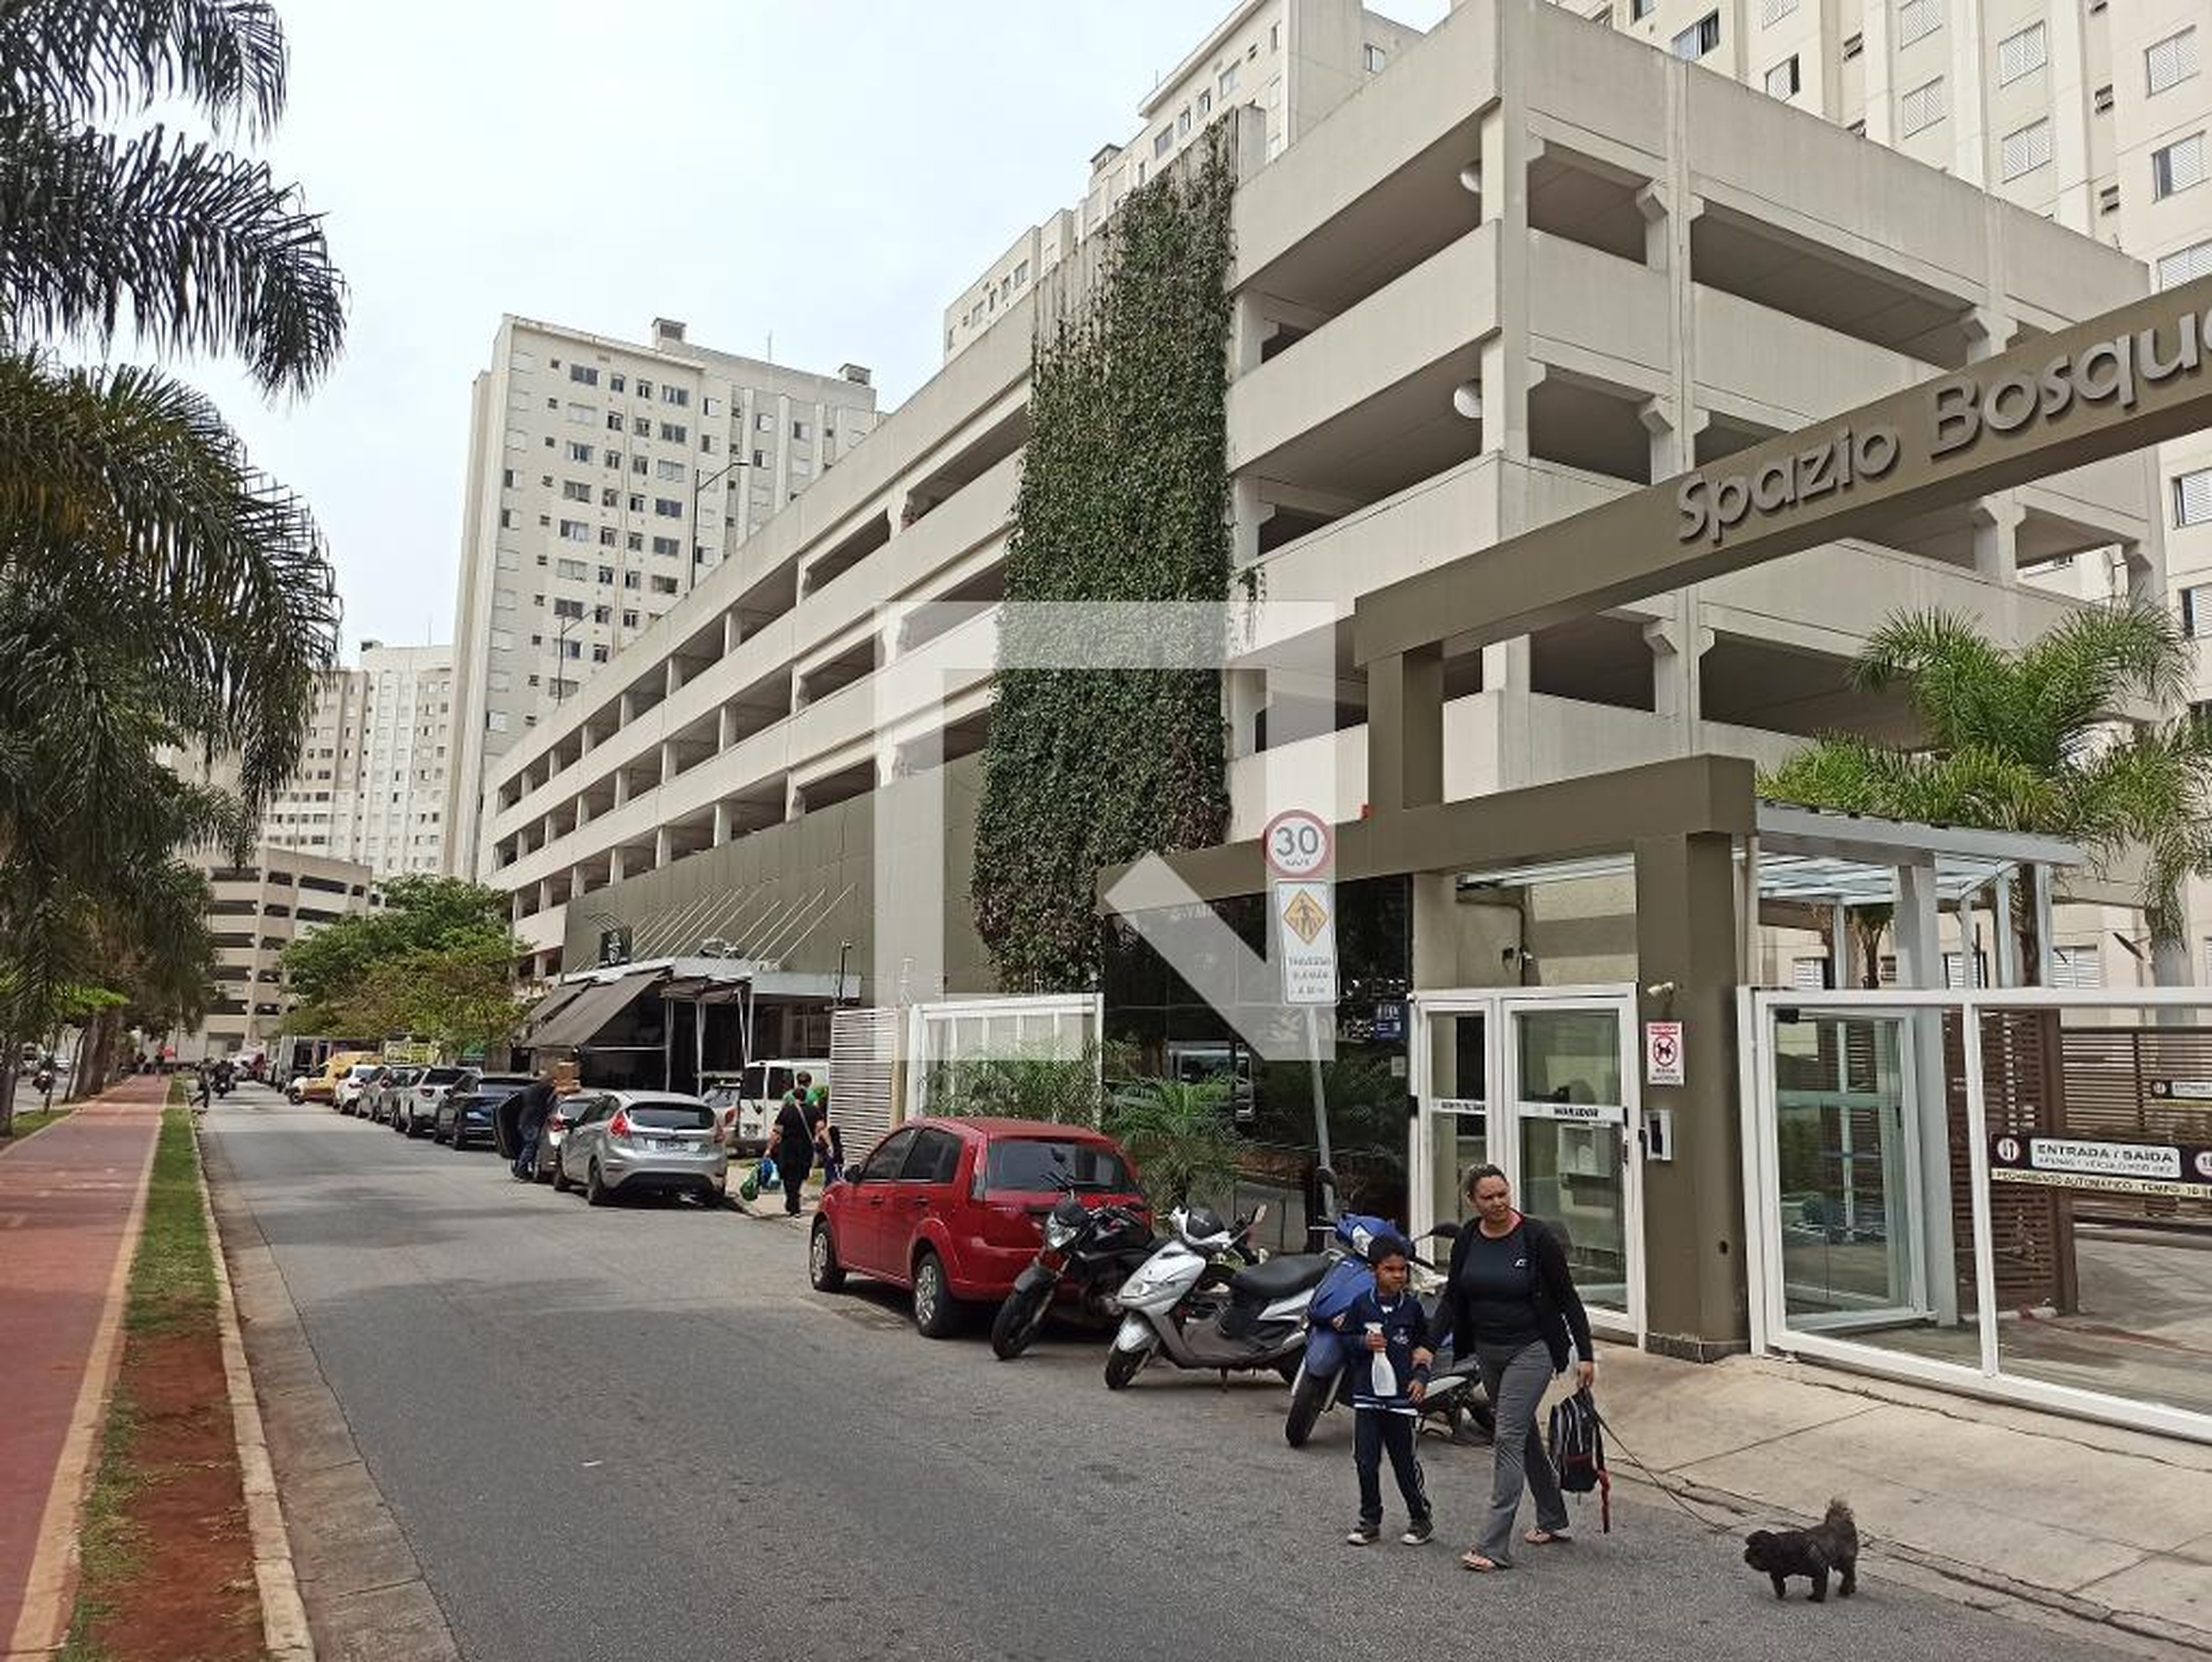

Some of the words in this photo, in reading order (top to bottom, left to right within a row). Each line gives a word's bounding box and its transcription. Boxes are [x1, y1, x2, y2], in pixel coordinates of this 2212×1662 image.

[1676, 422, 1900, 544] Spazio
[1929, 305, 2212, 462] Bosqu
[1276, 825, 1318, 857] 30
[2037, 1144, 2109, 1159] ENTRADA
[2123, 1149, 2173, 1163] SAÍDA
